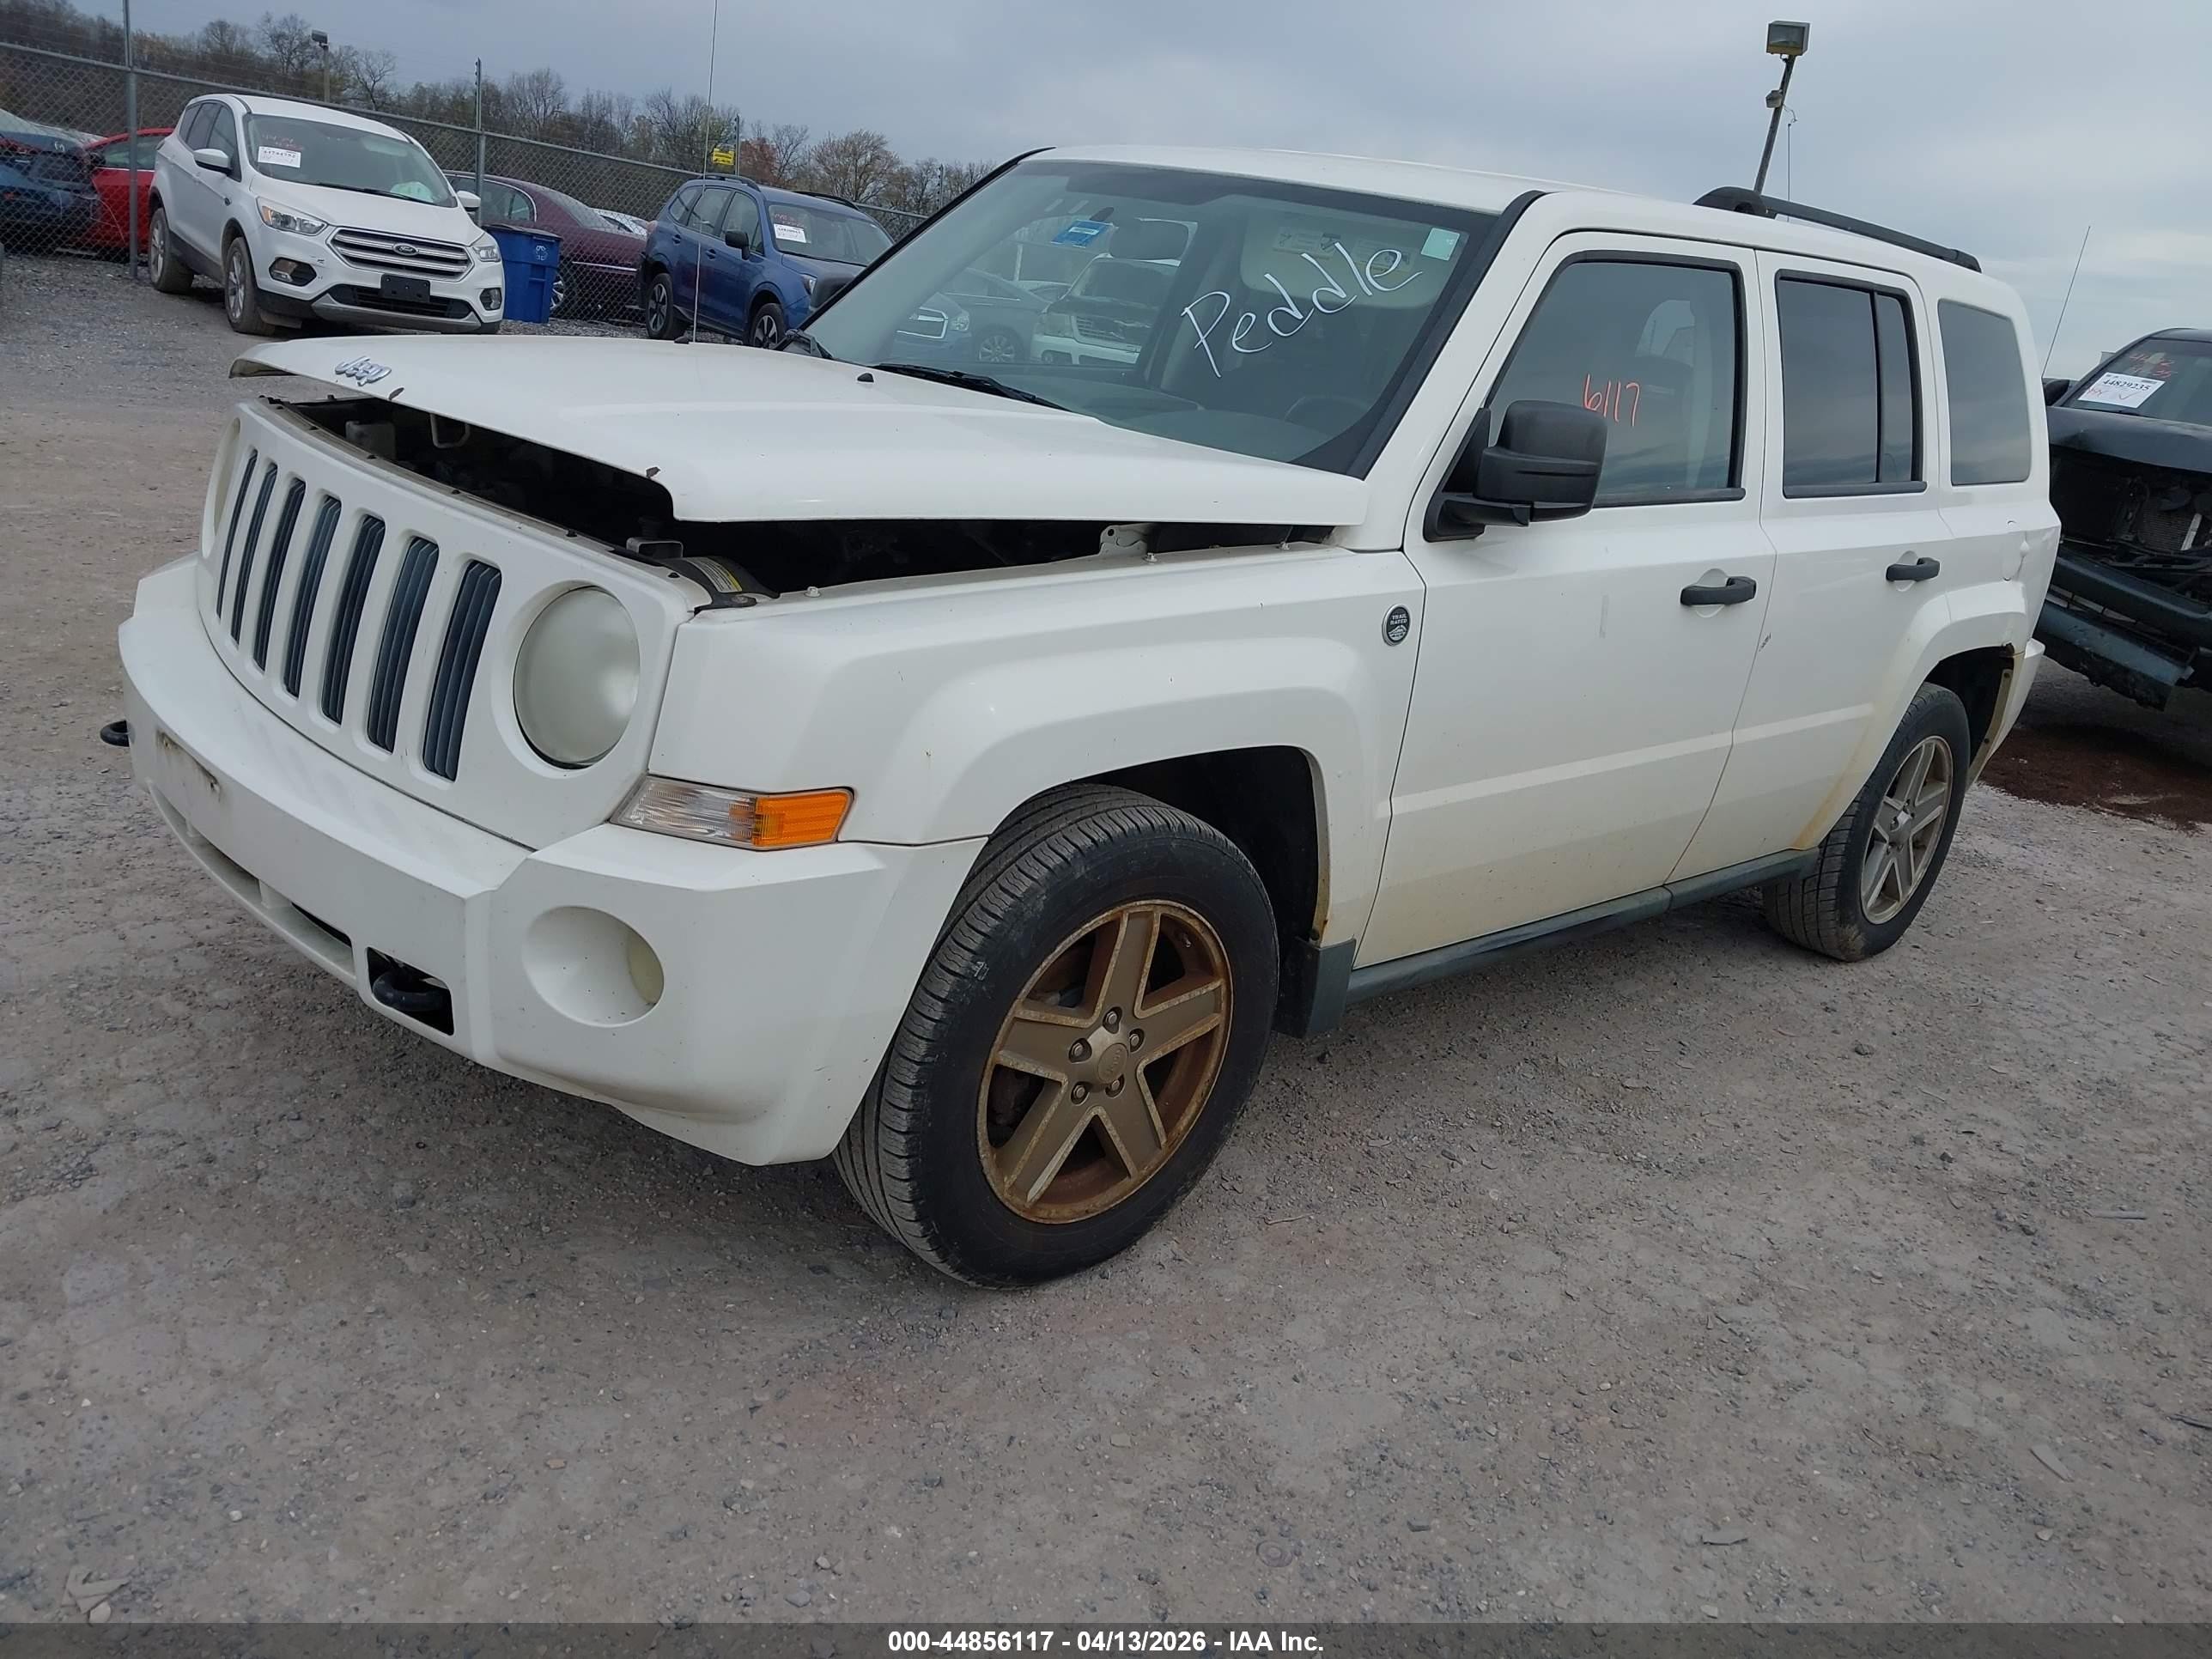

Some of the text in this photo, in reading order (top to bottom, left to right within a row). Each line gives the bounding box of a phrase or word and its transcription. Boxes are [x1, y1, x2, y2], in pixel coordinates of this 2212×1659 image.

[1181, 241, 1424, 379] Peddle
[334, 356, 392, 387] Jeep
[2102, 378, 2152, 392] 44829235
[1583, 373, 1641, 428] 6117
